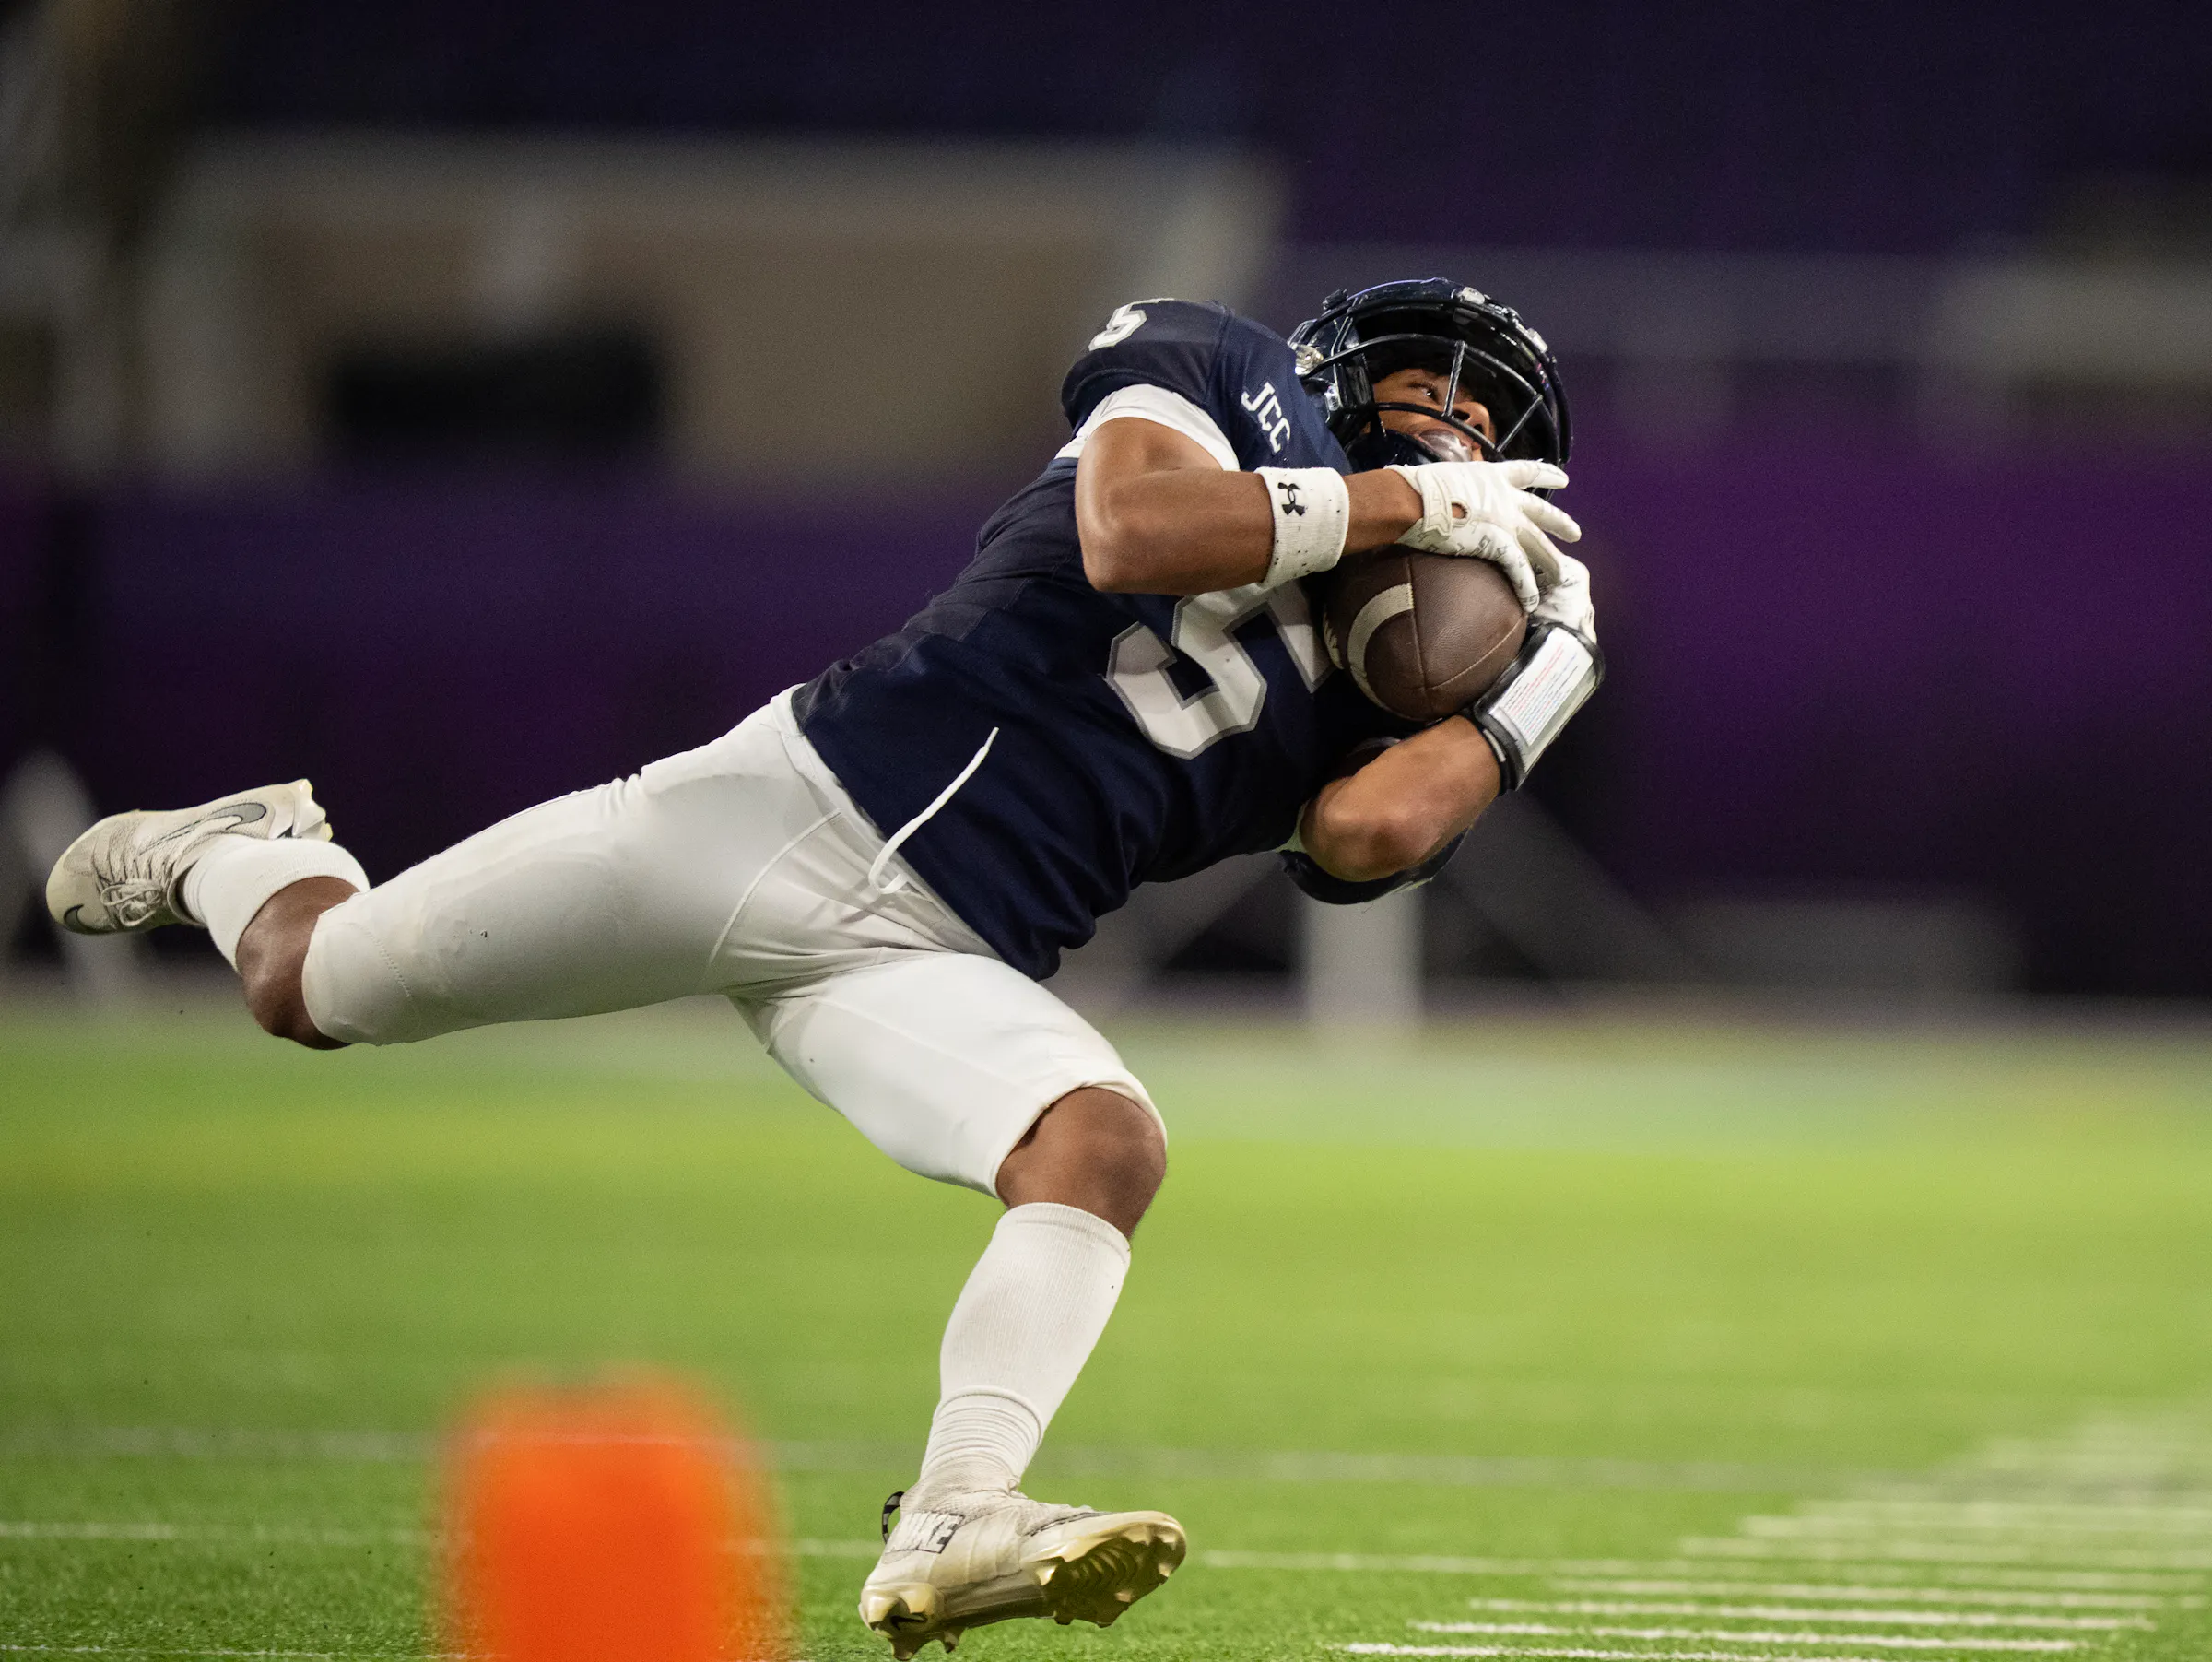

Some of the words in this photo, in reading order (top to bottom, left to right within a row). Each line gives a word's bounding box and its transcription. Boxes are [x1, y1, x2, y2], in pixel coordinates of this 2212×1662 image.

[1088, 297, 1174, 352] 5
[1241, 381, 1291, 454] JCC
[1106, 575, 1334, 760] 5
